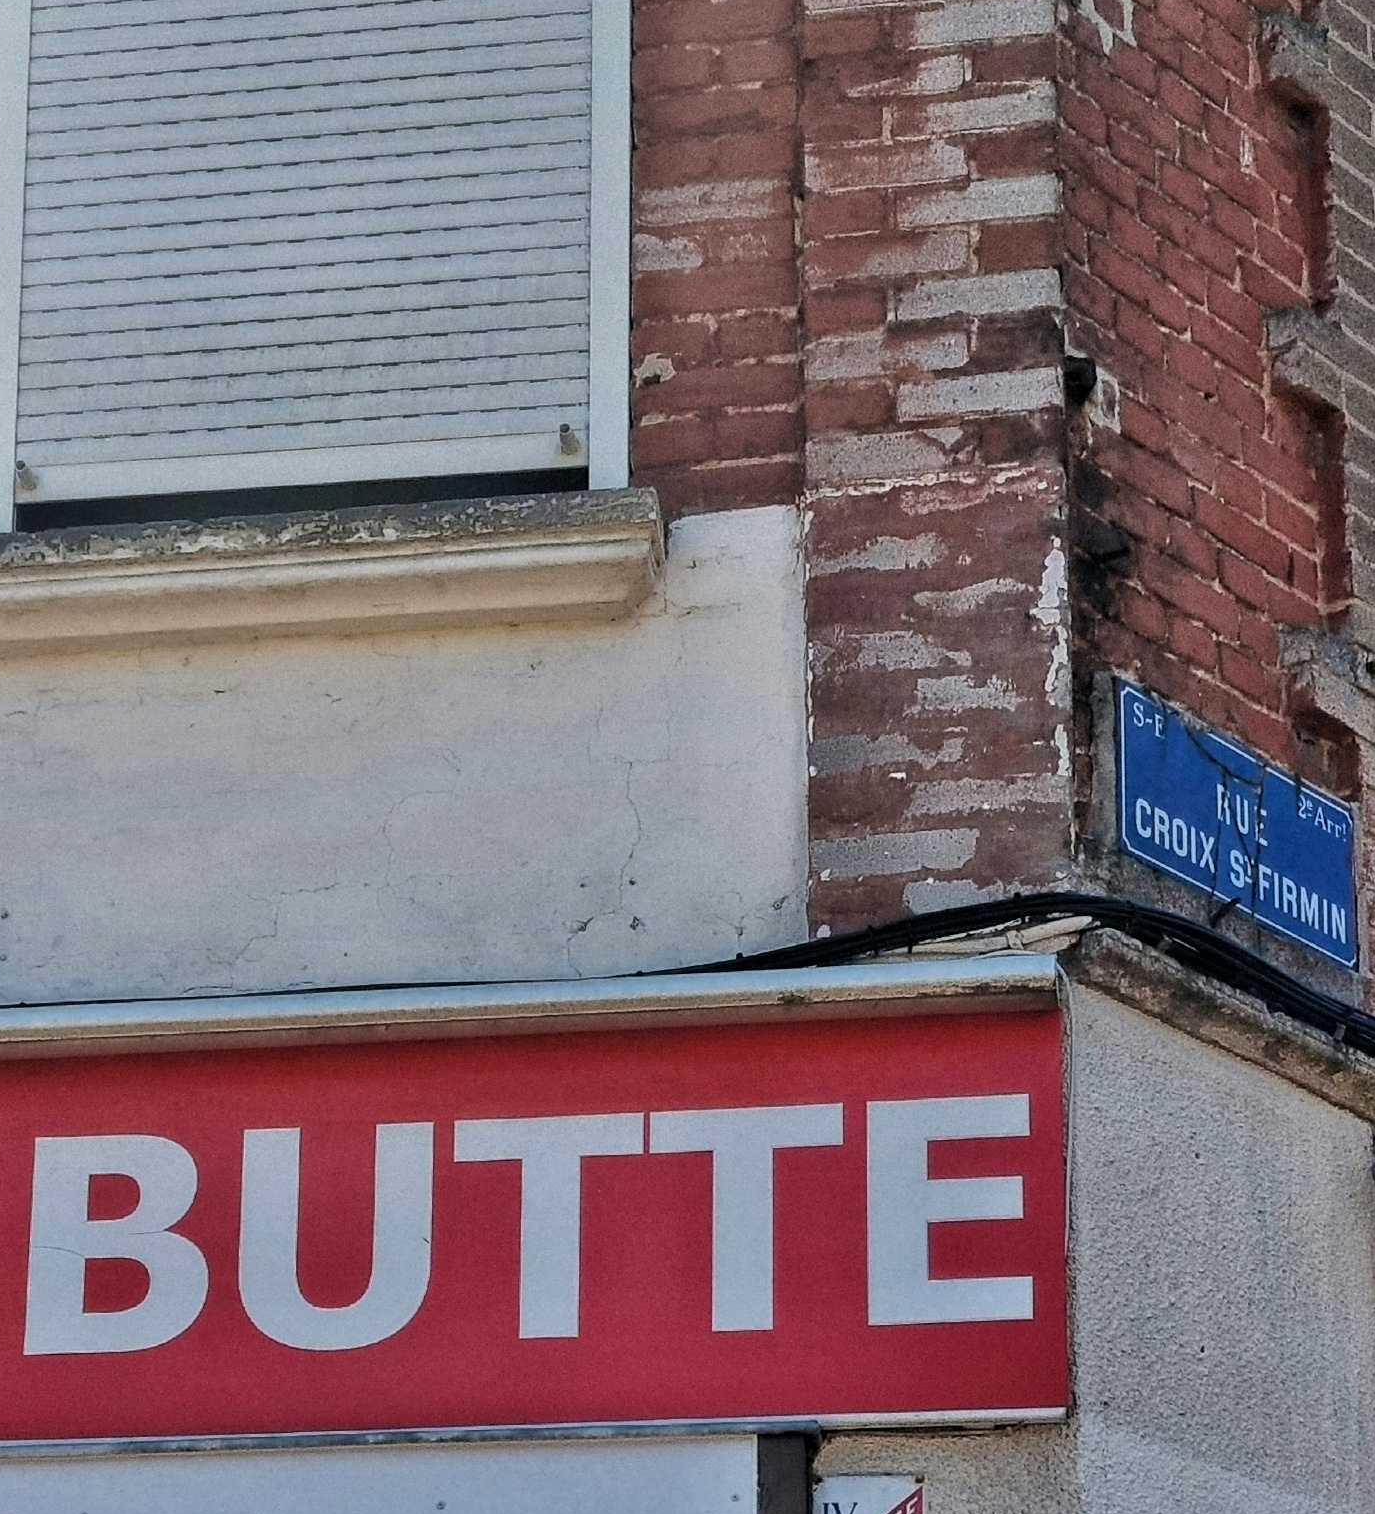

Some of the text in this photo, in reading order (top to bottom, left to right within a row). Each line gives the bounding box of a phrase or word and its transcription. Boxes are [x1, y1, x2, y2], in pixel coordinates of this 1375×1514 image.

[1135, 799, 1216, 873] CROIX
[1258, 864, 1347, 944] FIRMIN
[1216, 784, 1268, 847] RUE
[23, 1092, 1035, 1358] BUTTE
